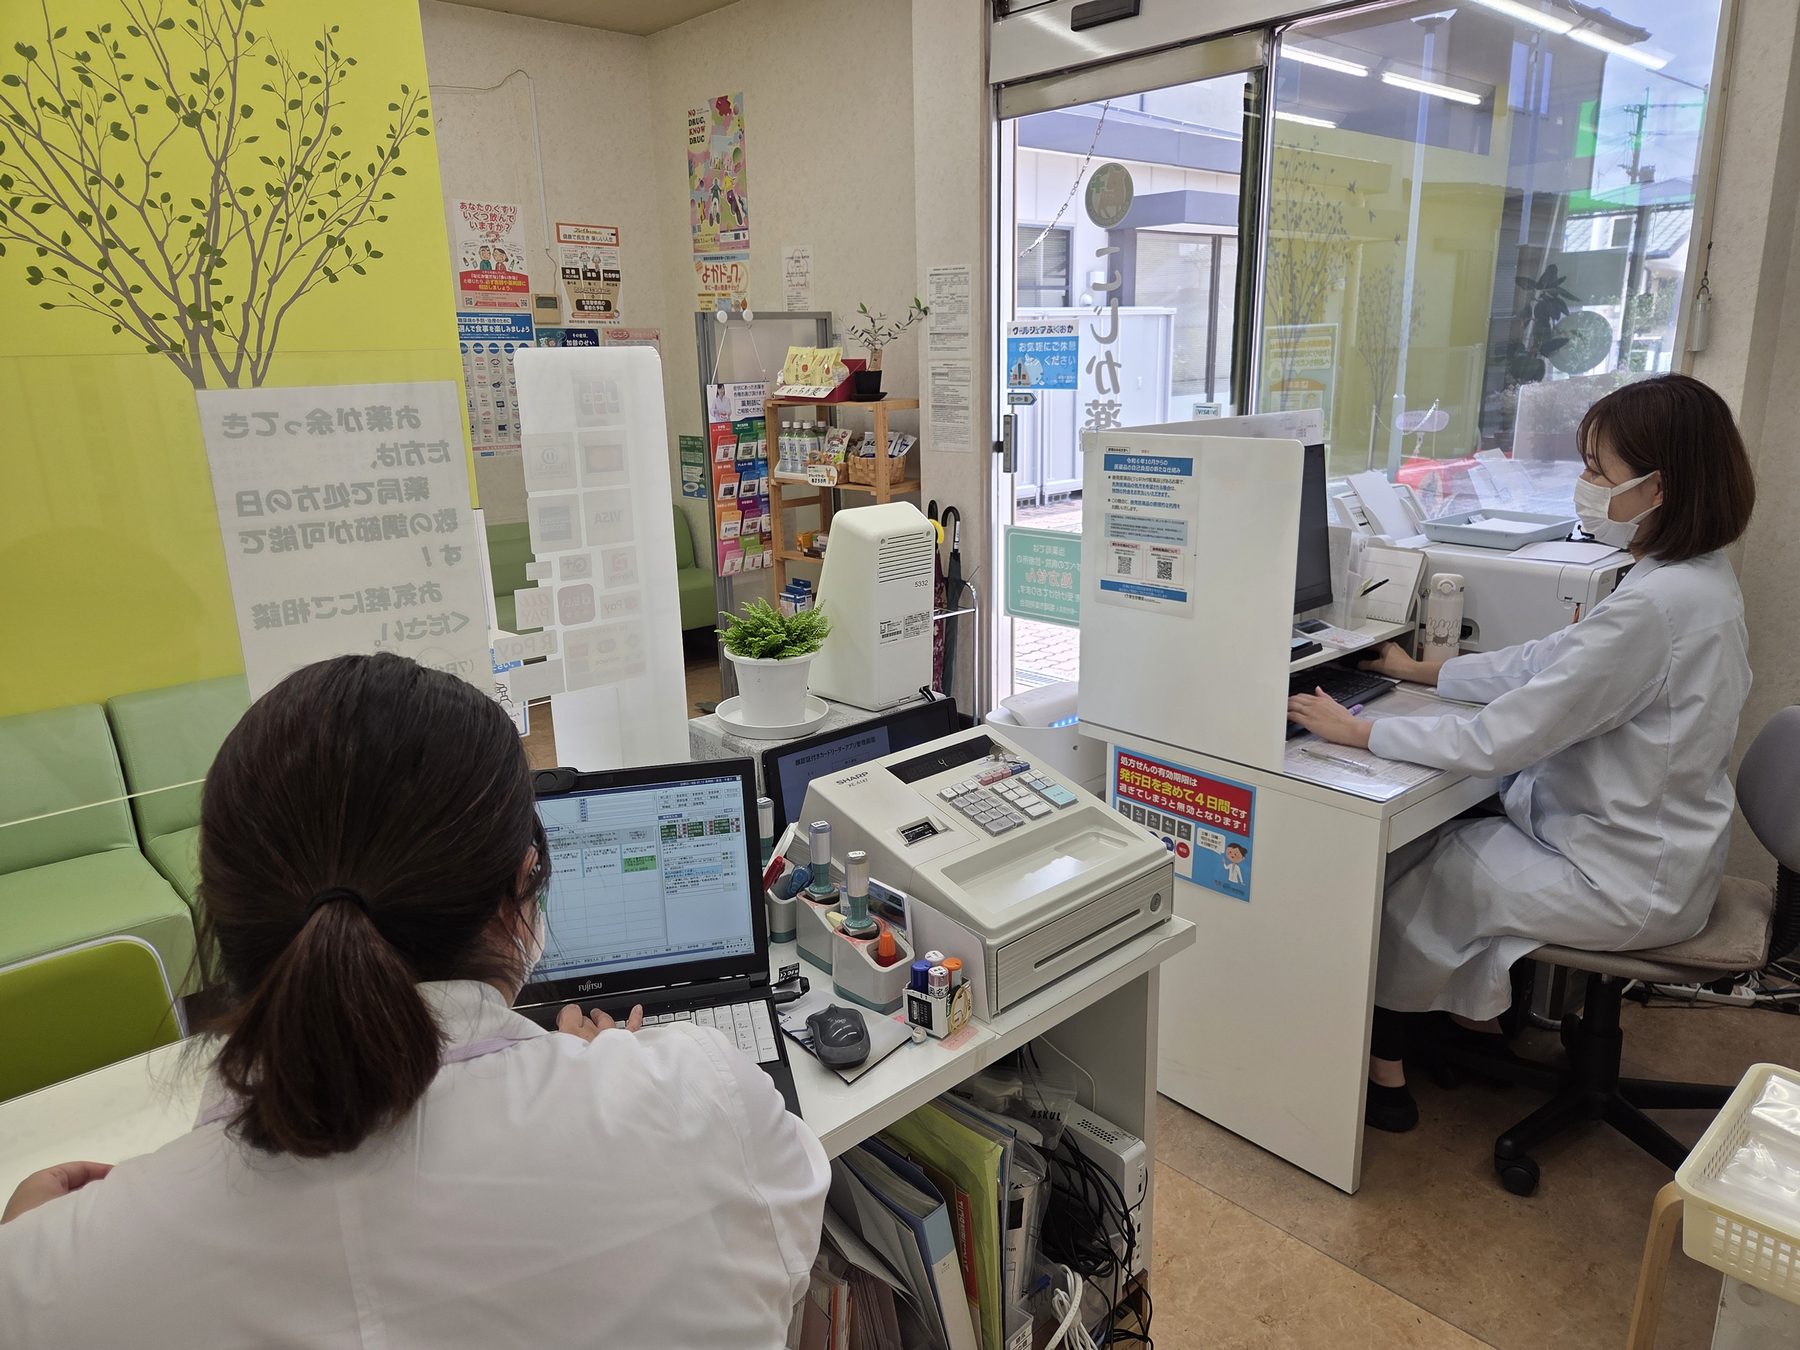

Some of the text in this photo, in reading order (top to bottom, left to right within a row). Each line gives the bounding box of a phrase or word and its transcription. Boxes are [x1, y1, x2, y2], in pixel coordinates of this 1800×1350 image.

[688, 109, 696, 117] NO
[689, 126, 705, 135] KNOW
[689, 135, 705, 144] DRUG
[460, 202, 517, 214] あなたのくすり
[463, 211, 516, 223] いくつ飲んで
[1085, 246, 1122, 428] こじか薬
[1044, 355, 1077, 366] ください
[1120, 756, 1198, 787] 処方せんの有効期限は
[836, 771, 869, 785] SHARP
[1119, 767, 1248, 819] 発行日を含めて4日間です
[1119, 783, 1248, 832] 過ぎてしまうと無効となります！
[578, 981, 603, 992] FUJITSU
[1031, 1110, 1061, 1121] ASKUL
